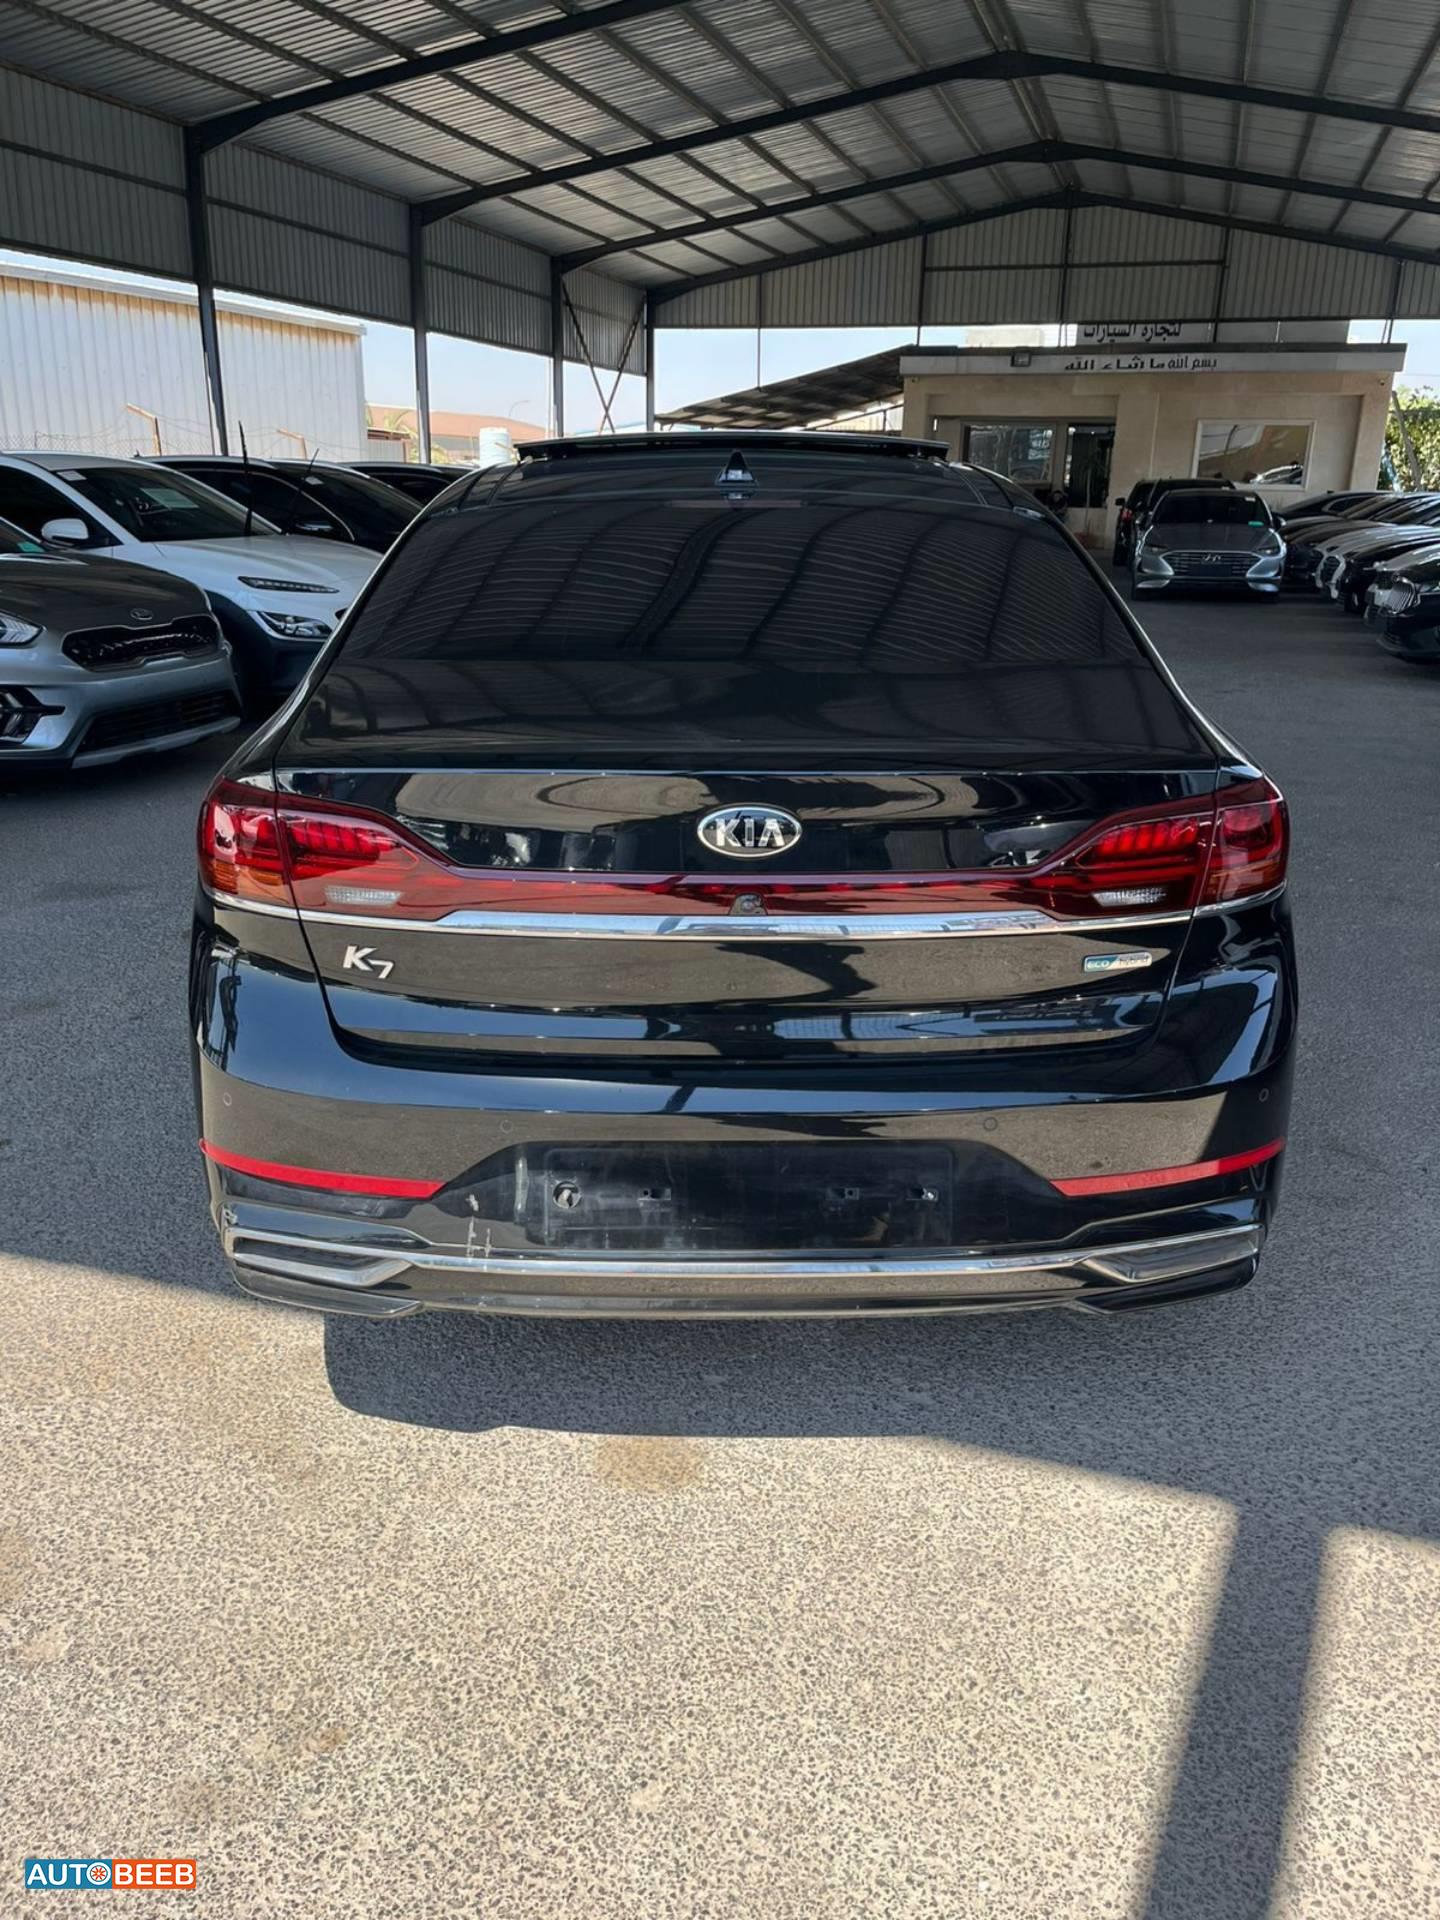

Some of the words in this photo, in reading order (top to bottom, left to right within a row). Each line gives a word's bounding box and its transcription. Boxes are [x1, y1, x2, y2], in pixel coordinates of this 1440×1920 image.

[1064, 357, 1095, 371] الله
[1150, 358, 1165, 369] ما
[1168, 354, 1189, 369] الله
[1192, 358, 1218, 370] بسم
[715, 818, 785, 847] KIA
[342, 945, 395, 979] K7
